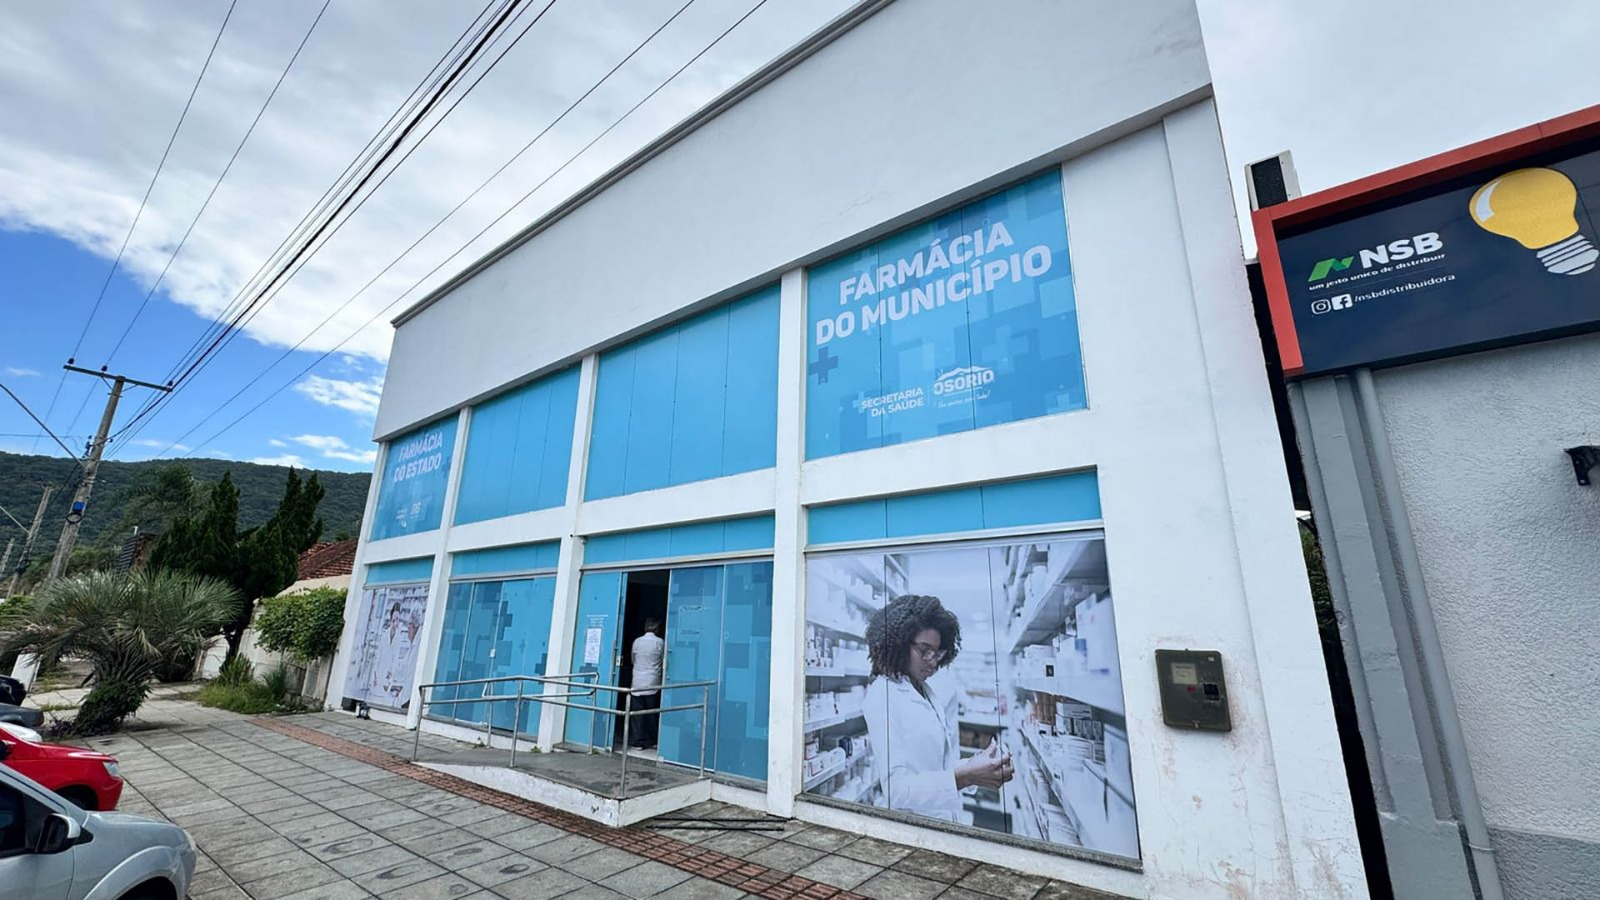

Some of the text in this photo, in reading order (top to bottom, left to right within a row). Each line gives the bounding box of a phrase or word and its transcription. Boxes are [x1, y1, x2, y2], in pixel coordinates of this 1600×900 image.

[839, 221, 1014, 305] FARMÁCIA
[1359, 231, 1443, 269] NSB
[1309, 283, 1325, 291] um
[1325, 277, 1349, 288] jeito
[1380, 265, 1394, 273] de
[1395, 253, 1446, 270] distribuir
[816, 245, 1053, 345] DO MUNICÍPIO
[861, 387, 924, 410] SECRETARIA
[871, 407, 886, 417] DA
[398, 432, 443, 463] FARMÁCIA
[406, 452, 442, 478] ESTADO
